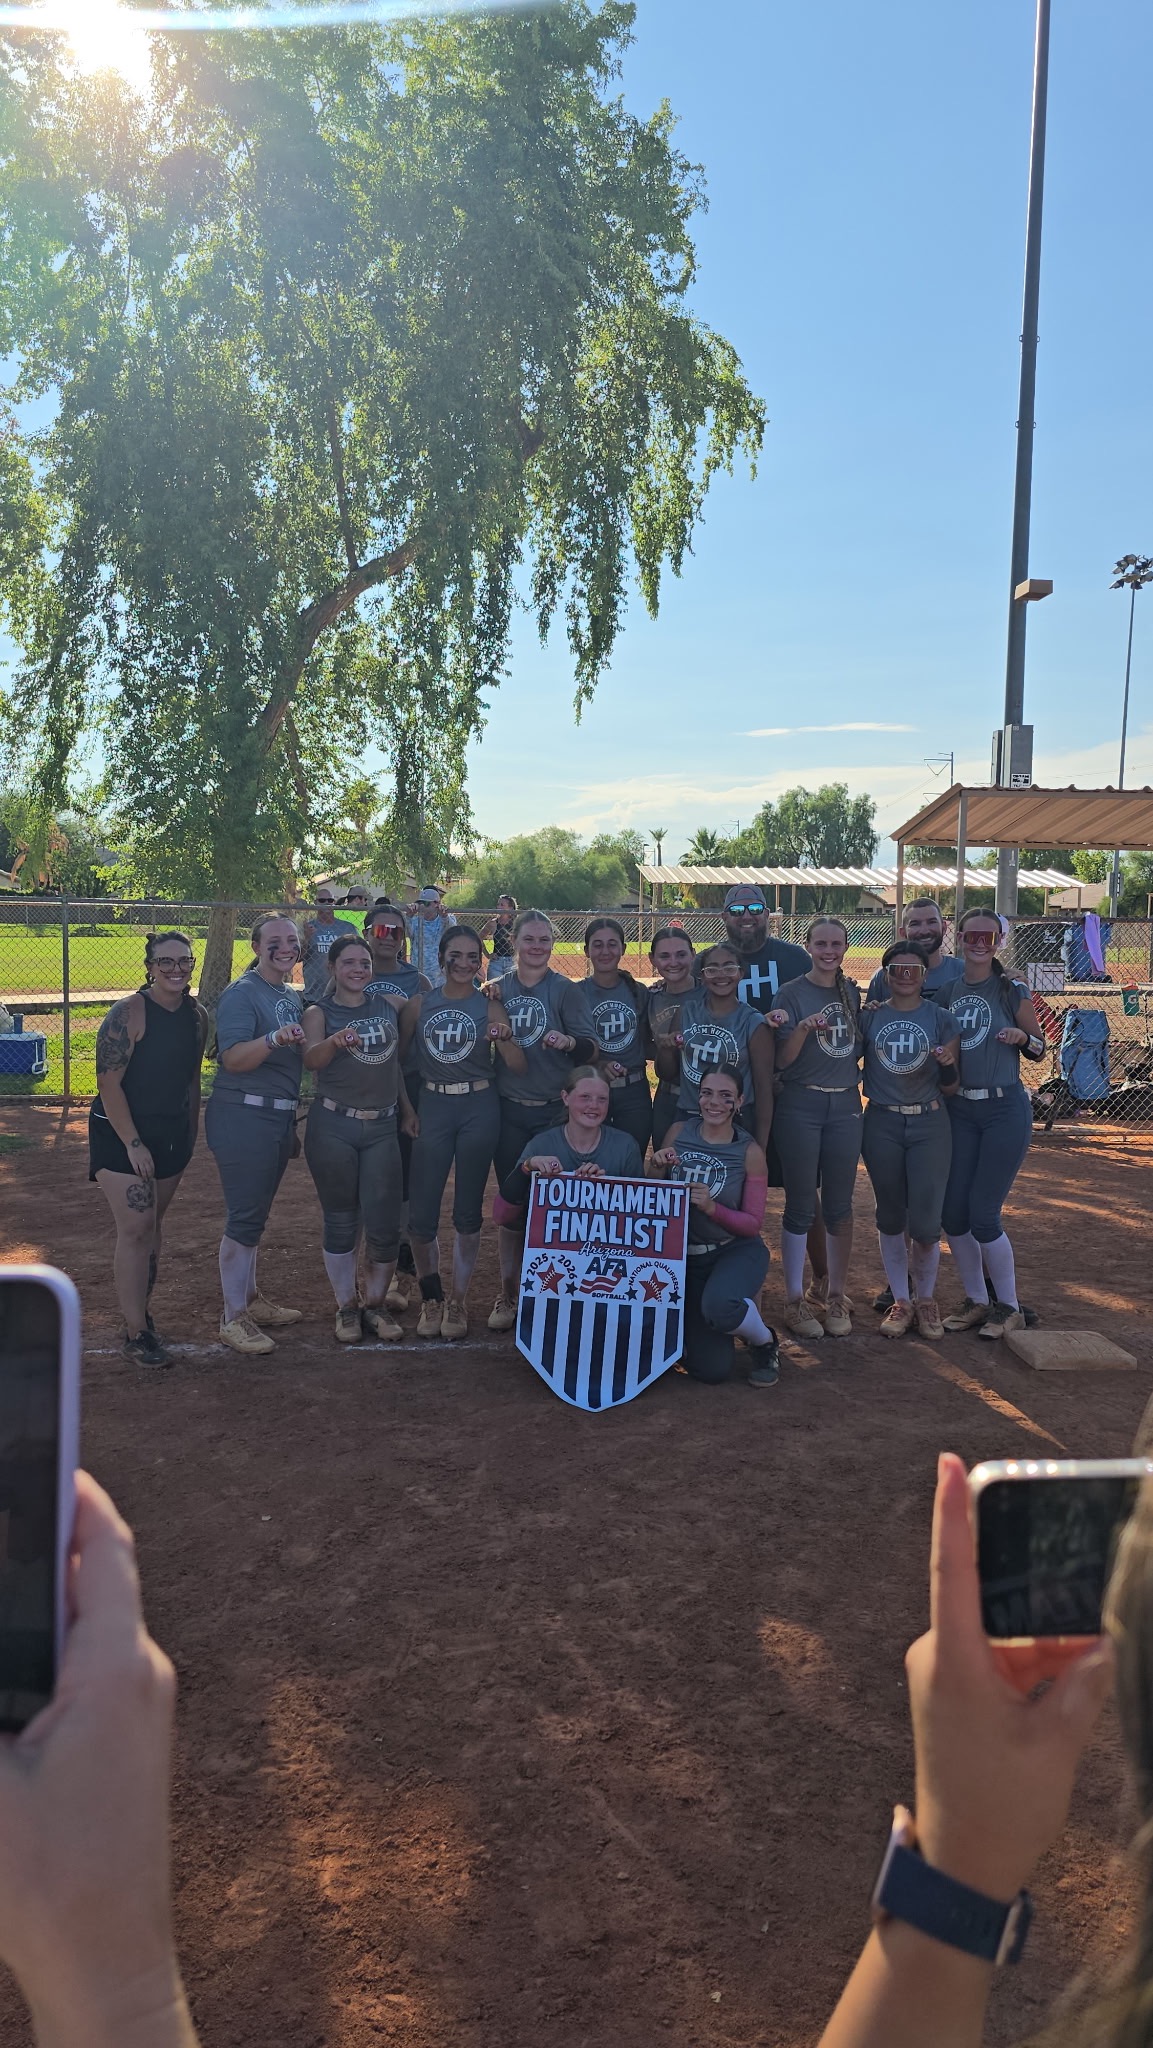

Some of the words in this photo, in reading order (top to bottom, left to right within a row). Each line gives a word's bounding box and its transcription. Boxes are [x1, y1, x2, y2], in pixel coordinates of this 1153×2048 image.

[430, 1012, 448, 1024] TEAM
[594, 1003, 609, 1017] TEAM
[881, 1023, 898, 1036] TEAM
[900, 1022, 923, 1037] HUSTLE
[537, 1178, 684, 1217] TOURNAMENT
[544, 1210, 668, 1252] FINALIST
[579, 1241, 636, 1260] Arizona
[526, 1253, 549, 1277] 2025
[557, 1254, 578, 1280] 2026
[585, 1257, 628, 1277] AFA
[628, 1260, 654, 1286] NATIONAL
[653, 1260, 680, 1291] QUALIFIERS
[591, 1292, 627, 1301] SOFTBALL
